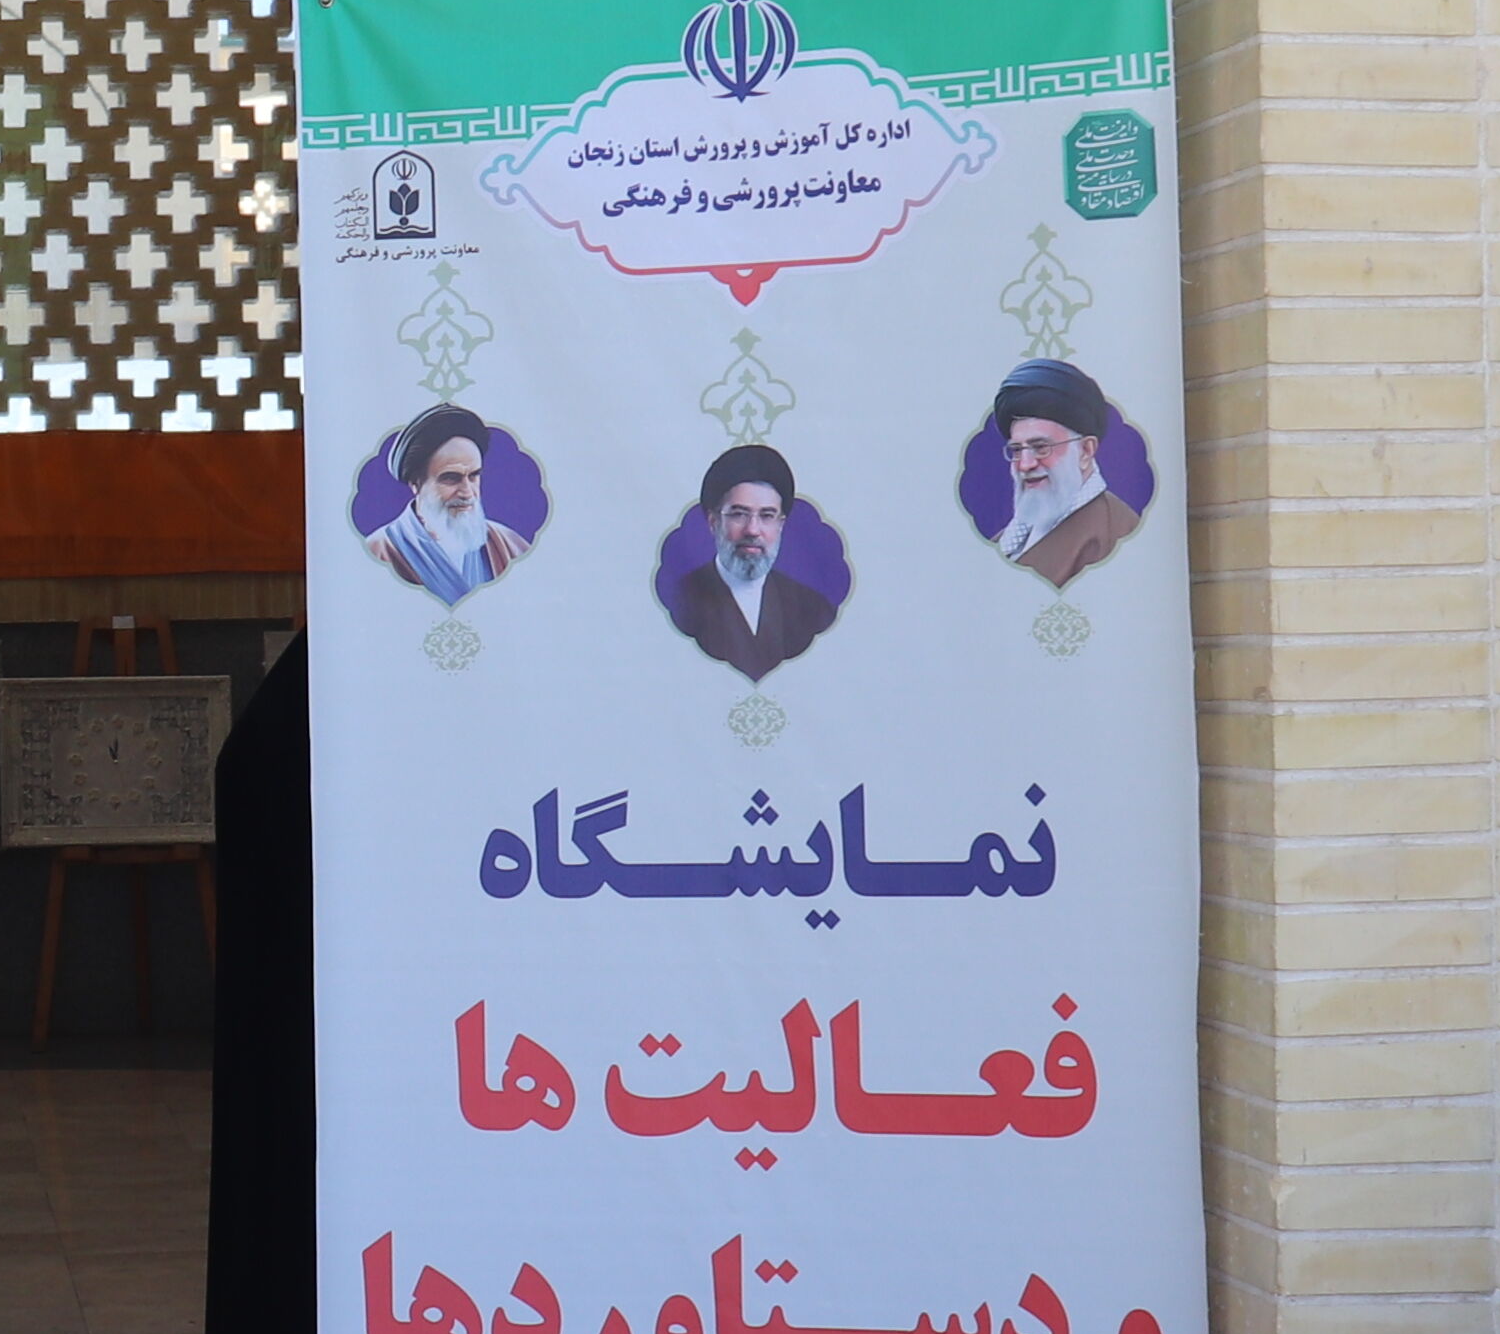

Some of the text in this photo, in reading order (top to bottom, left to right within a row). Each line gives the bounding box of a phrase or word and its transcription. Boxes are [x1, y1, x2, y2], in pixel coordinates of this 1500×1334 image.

[568, 119, 911, 169] اداره کل آموزش و پرورش استان زنجان
[603, 169, 881, 217] معاونت پرورشی و فرهنگی
[336, 246, 379, 263] فرهنگی
[391, 245, 437, 260] پرورشی
[440, 244, 480, 257] معاونت
[479, 782, 1057, 930] نمایشگاه
[454, 993, 1097, 1172] فعالیت ها
